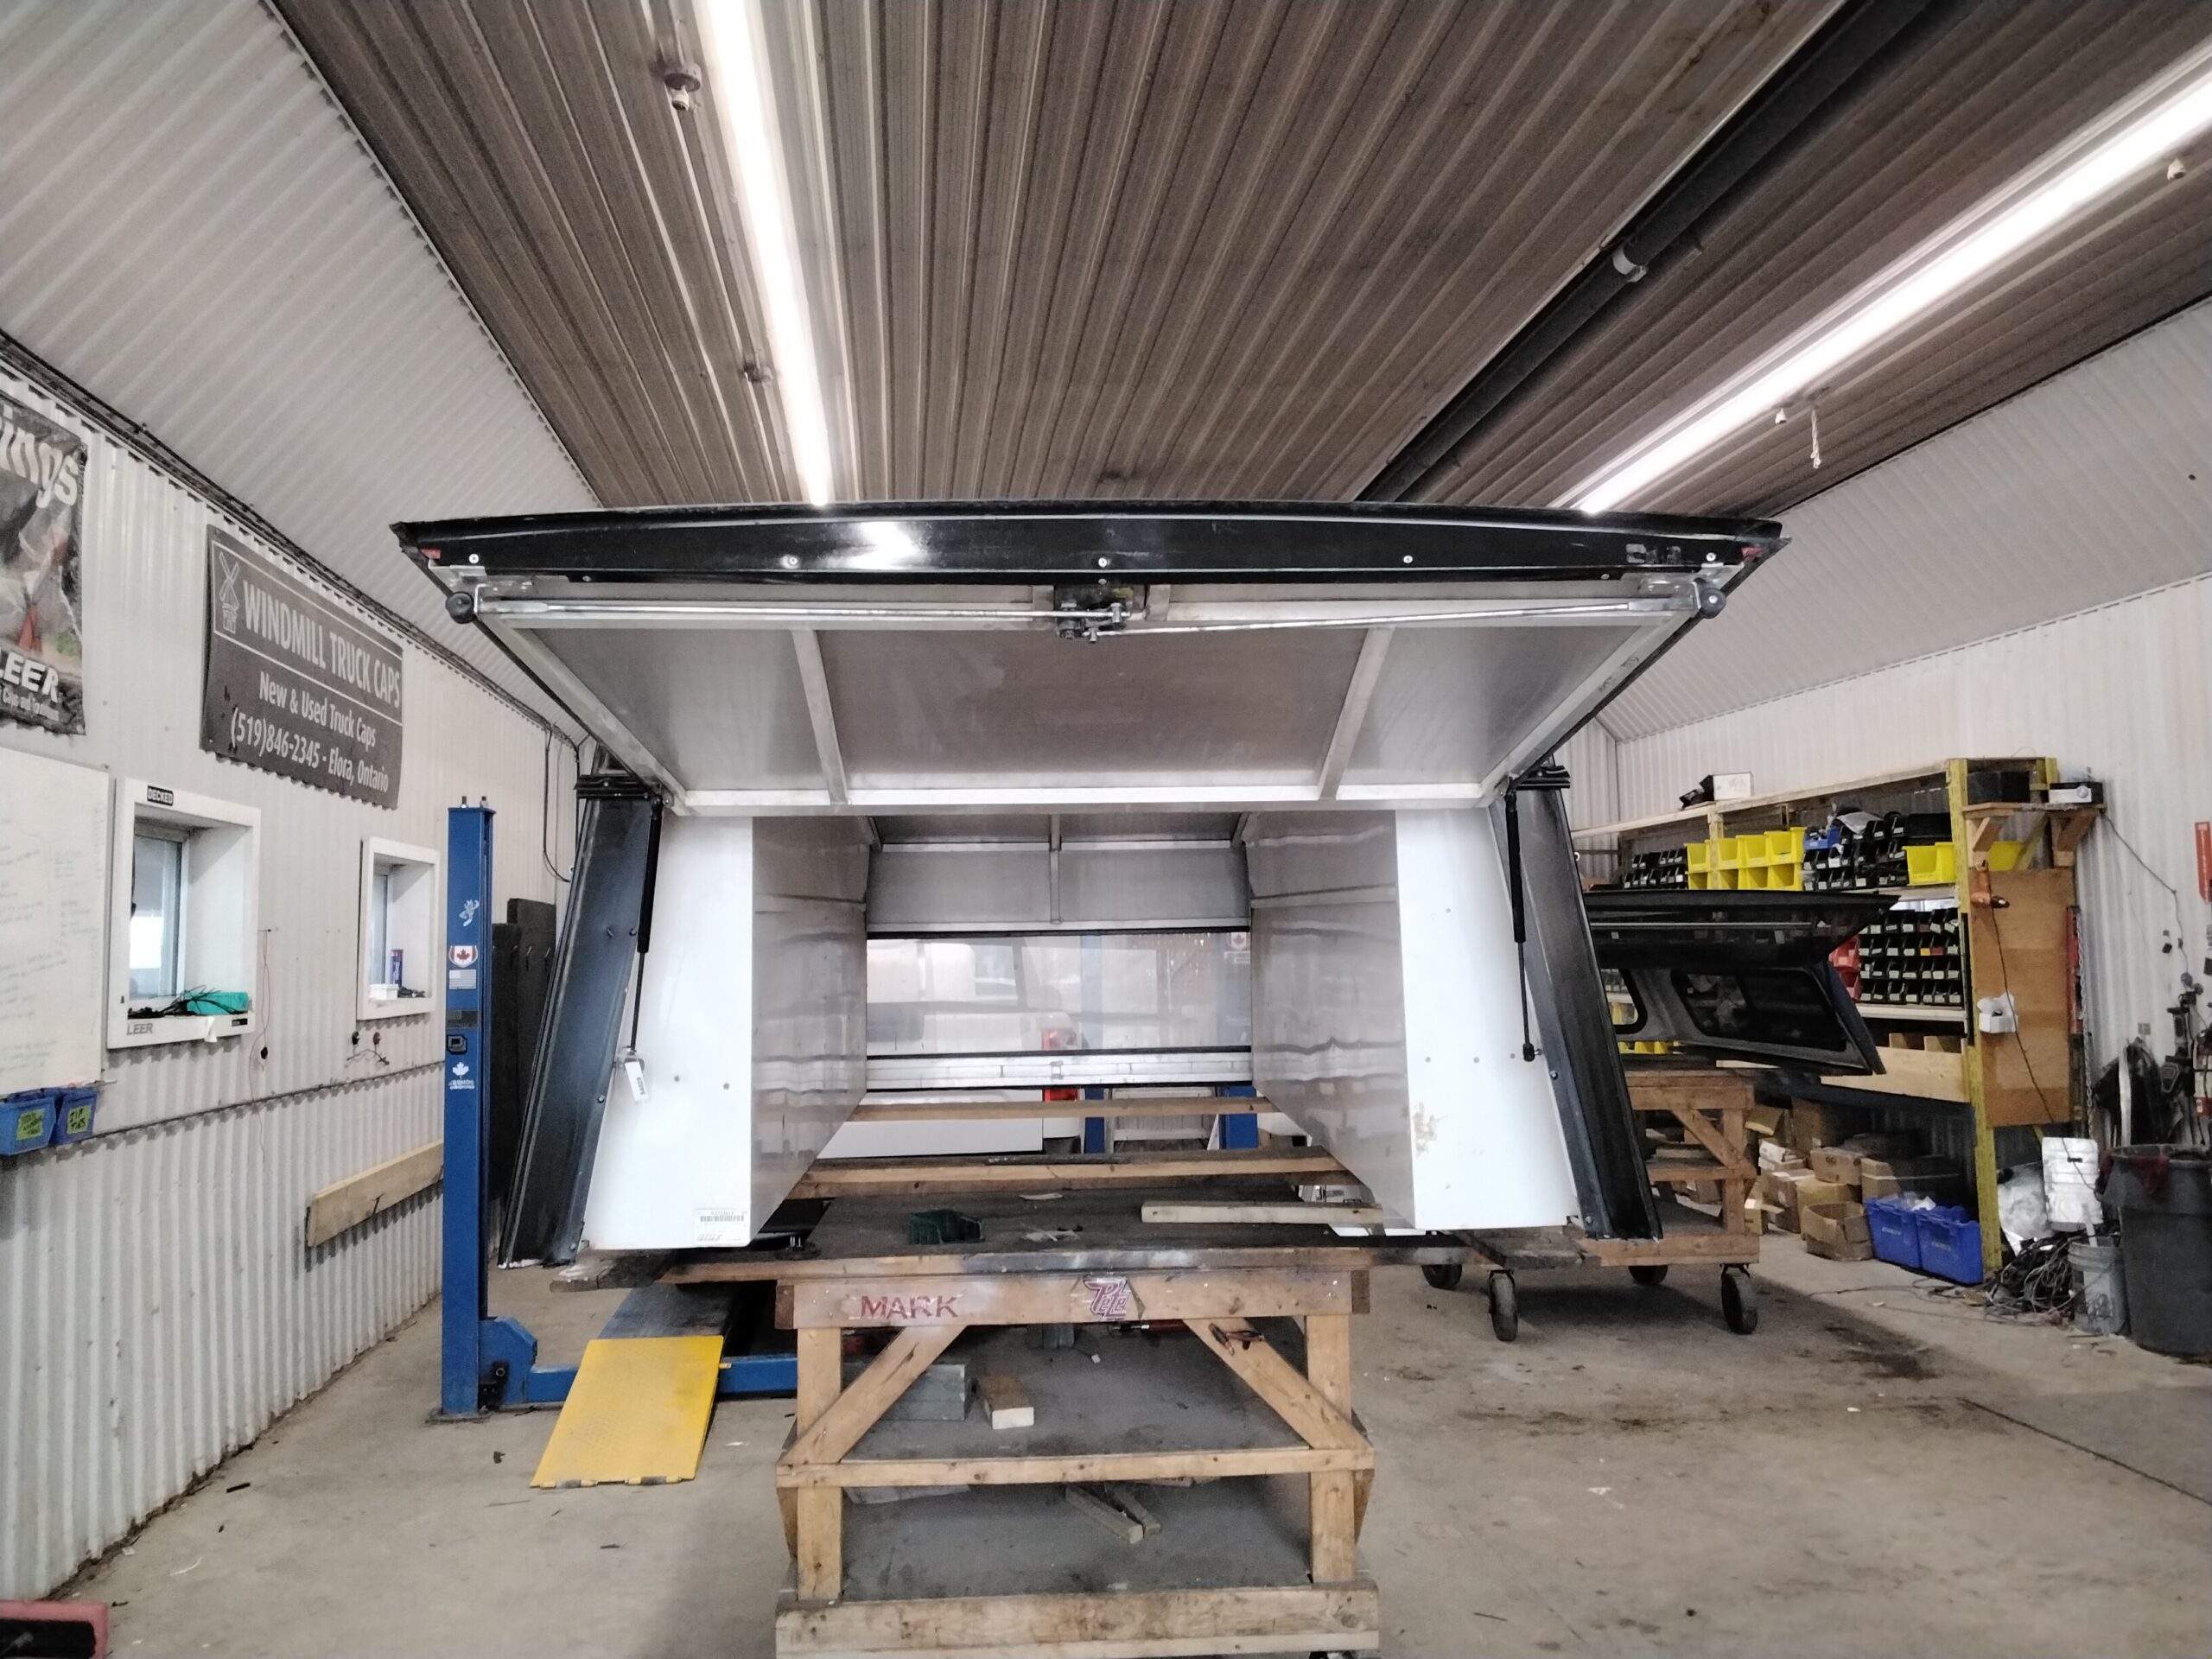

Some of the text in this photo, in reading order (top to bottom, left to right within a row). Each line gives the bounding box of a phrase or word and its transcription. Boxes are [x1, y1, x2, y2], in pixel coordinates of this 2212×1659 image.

[0, 404, 79, 508] ings
[243, 580, 400, 708] WINDMILL TRUCK CAPS
[0, 652, 59, 703] EER
[259, 671, 376, 751] New & Used Truck Caps
[231, 707, 321, 769] (519)846-2345
[328, 747, 355, 785] Elora,
[358, 760, 389, 793] Ontario
[148, 787, 173, 804] DECKED
[126, 1023, 153, 1035] LEER
[860, 1295, 958, 1319] MARK
